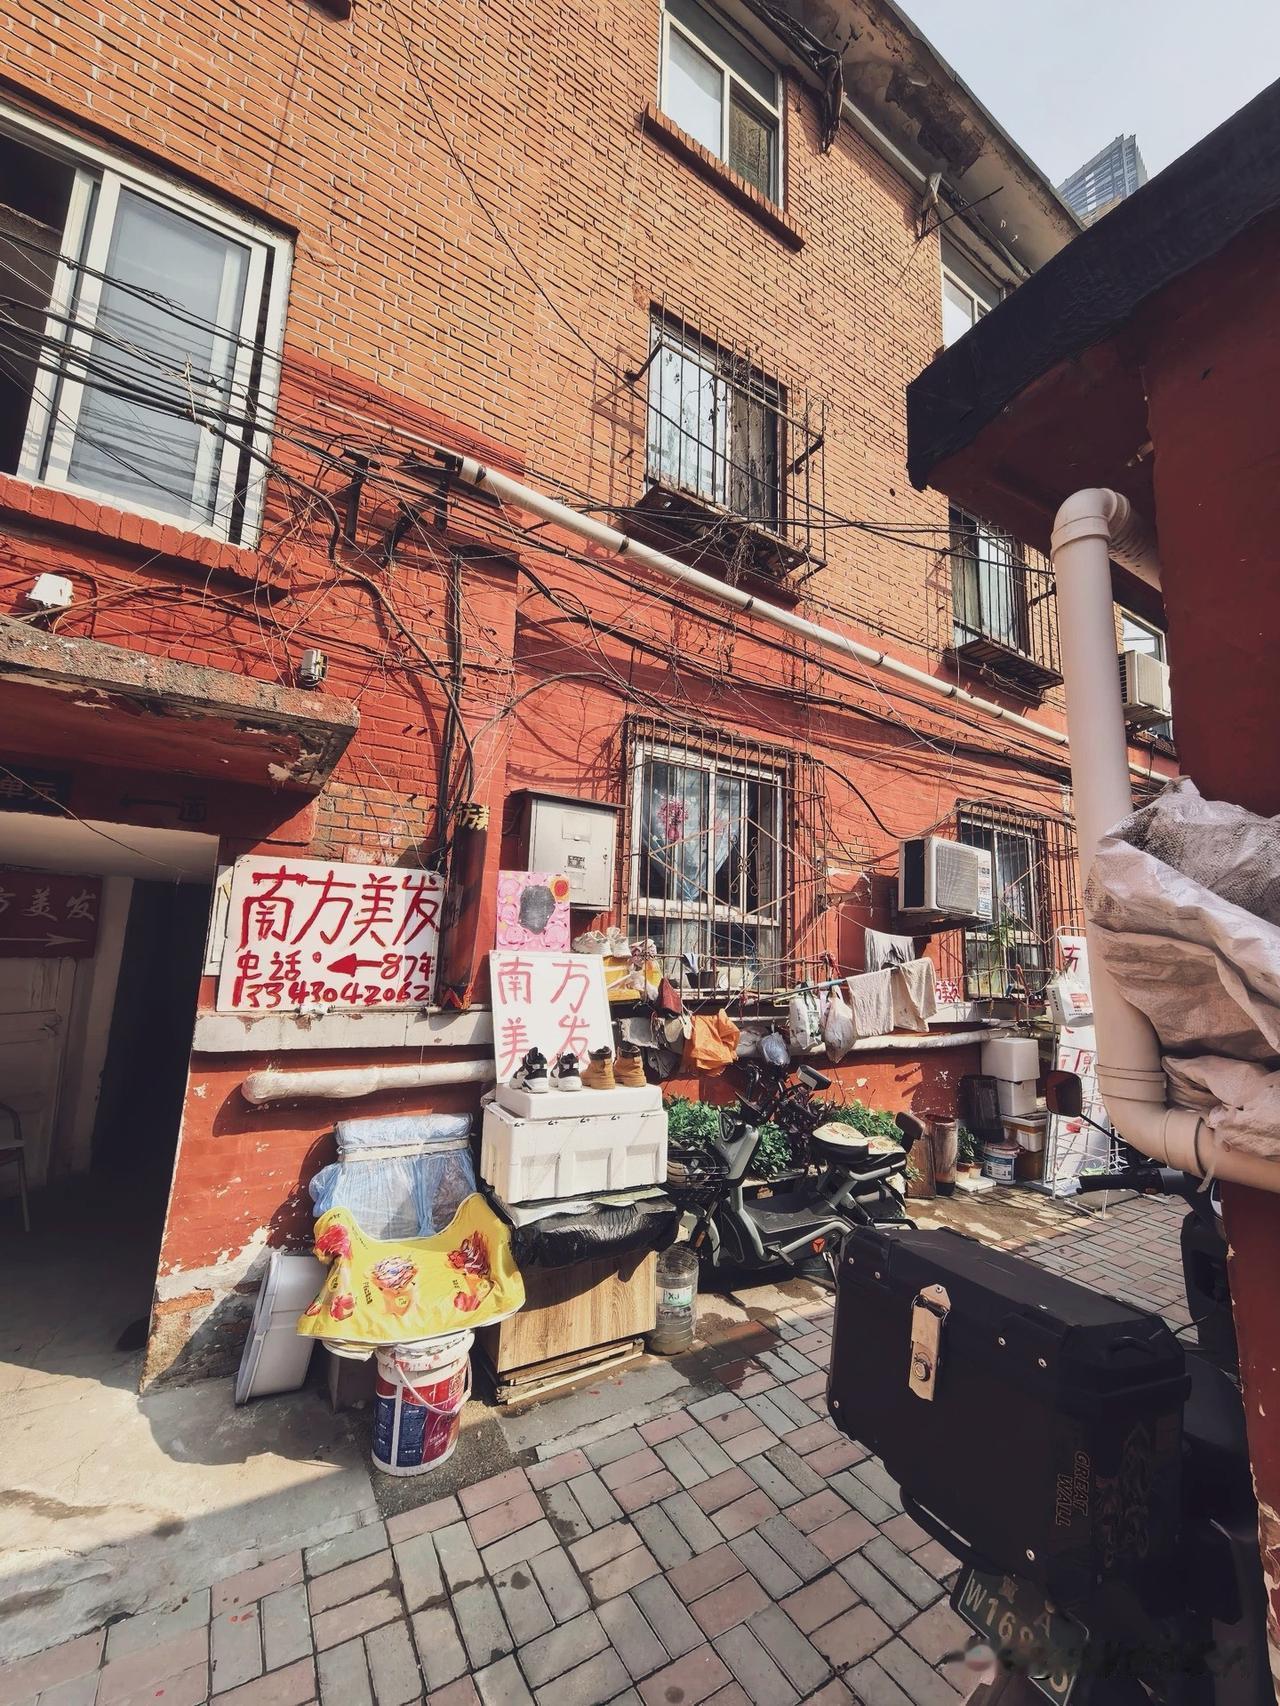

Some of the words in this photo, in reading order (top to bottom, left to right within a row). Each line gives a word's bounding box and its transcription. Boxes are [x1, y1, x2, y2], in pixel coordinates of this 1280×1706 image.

[235, 864, 443, 948] 南方美发
[236, 949, 303, 982] 电话
[496, 957, 591, 1013] 南方
[232, 974, 431, 1008] 13343042062
